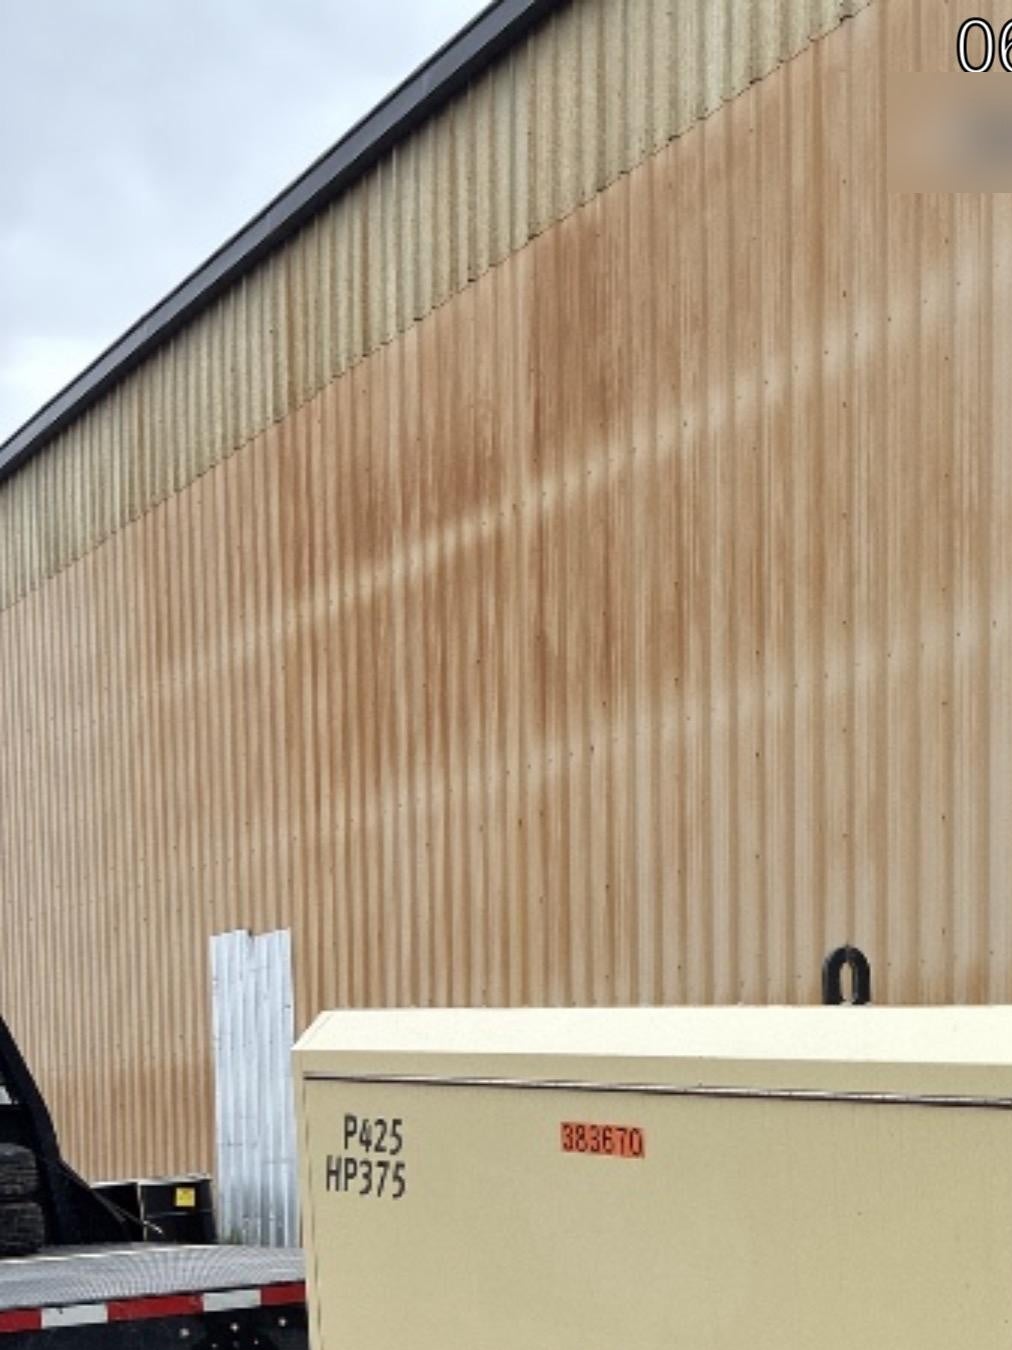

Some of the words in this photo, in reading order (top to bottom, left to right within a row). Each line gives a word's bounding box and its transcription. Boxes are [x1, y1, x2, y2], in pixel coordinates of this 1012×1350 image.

[344, 1114, 403, 1155] P425
[562, 1123, 643, 1156] 383670
[326, 1154, 406, 1199] HP375
